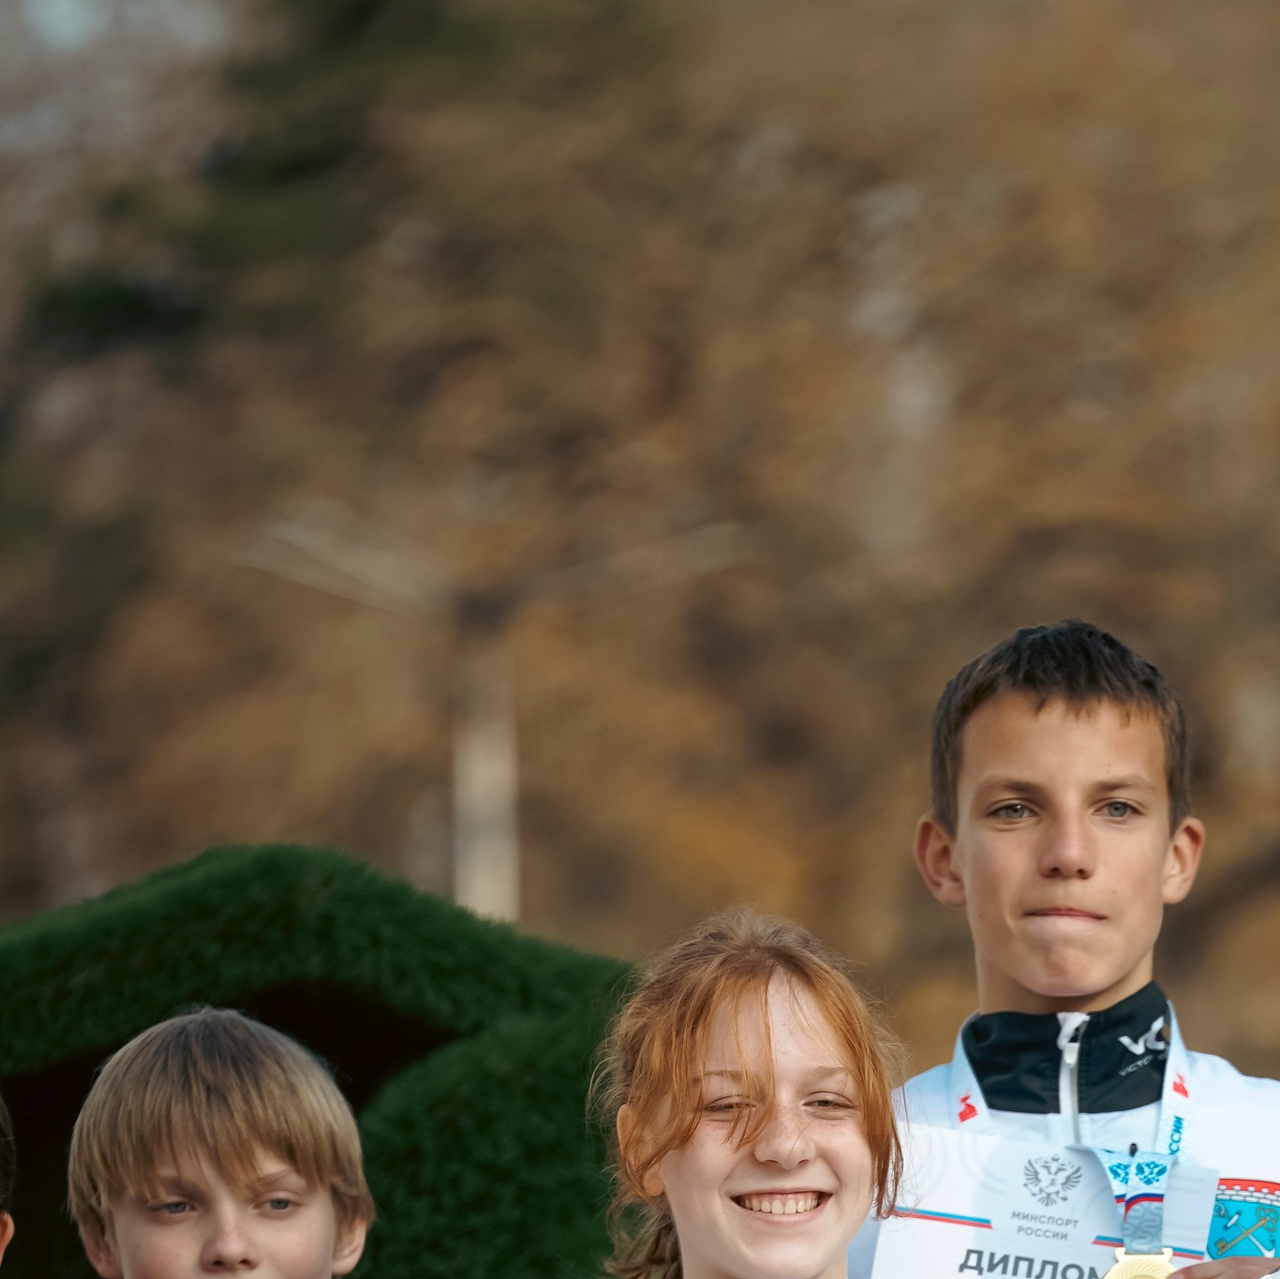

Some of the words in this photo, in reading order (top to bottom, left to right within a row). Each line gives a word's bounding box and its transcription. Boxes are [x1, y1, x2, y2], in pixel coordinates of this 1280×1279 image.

[1169, 1115, 1184, 1155] ССИИ
[1011, 1211, 1080, 1229] МИНСПОРТ
[1017, 1226, 1069, 1241] РОССИИ
